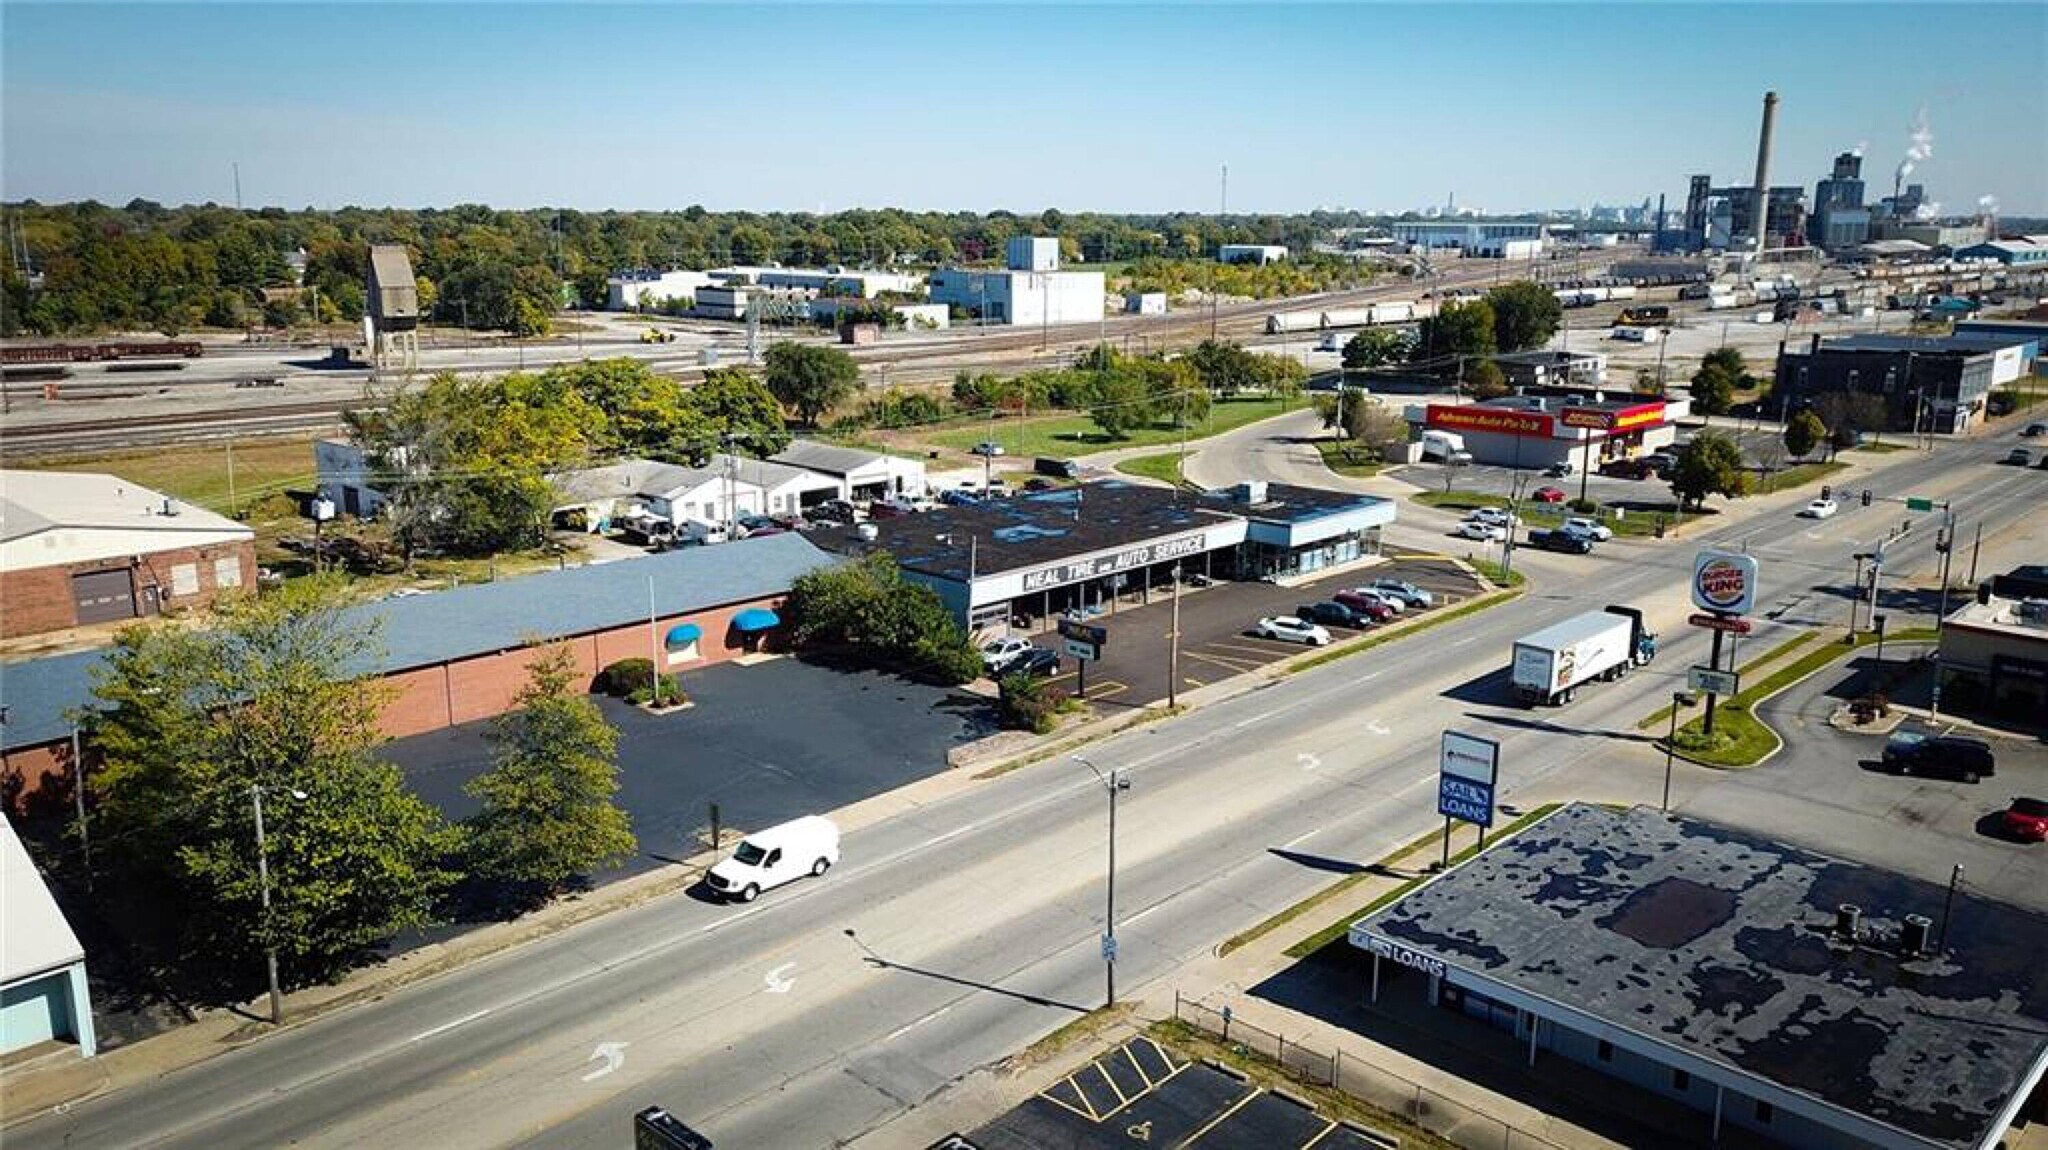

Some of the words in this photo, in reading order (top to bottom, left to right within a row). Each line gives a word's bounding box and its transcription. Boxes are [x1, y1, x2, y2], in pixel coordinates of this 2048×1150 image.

[1114, 550, 1150, 568] AUTO
[1153, 534, 1205, 560] SERVICE
[1441, 797, 1488, 821] LOANS
[1393, 947, 1444, 977] LOANS
